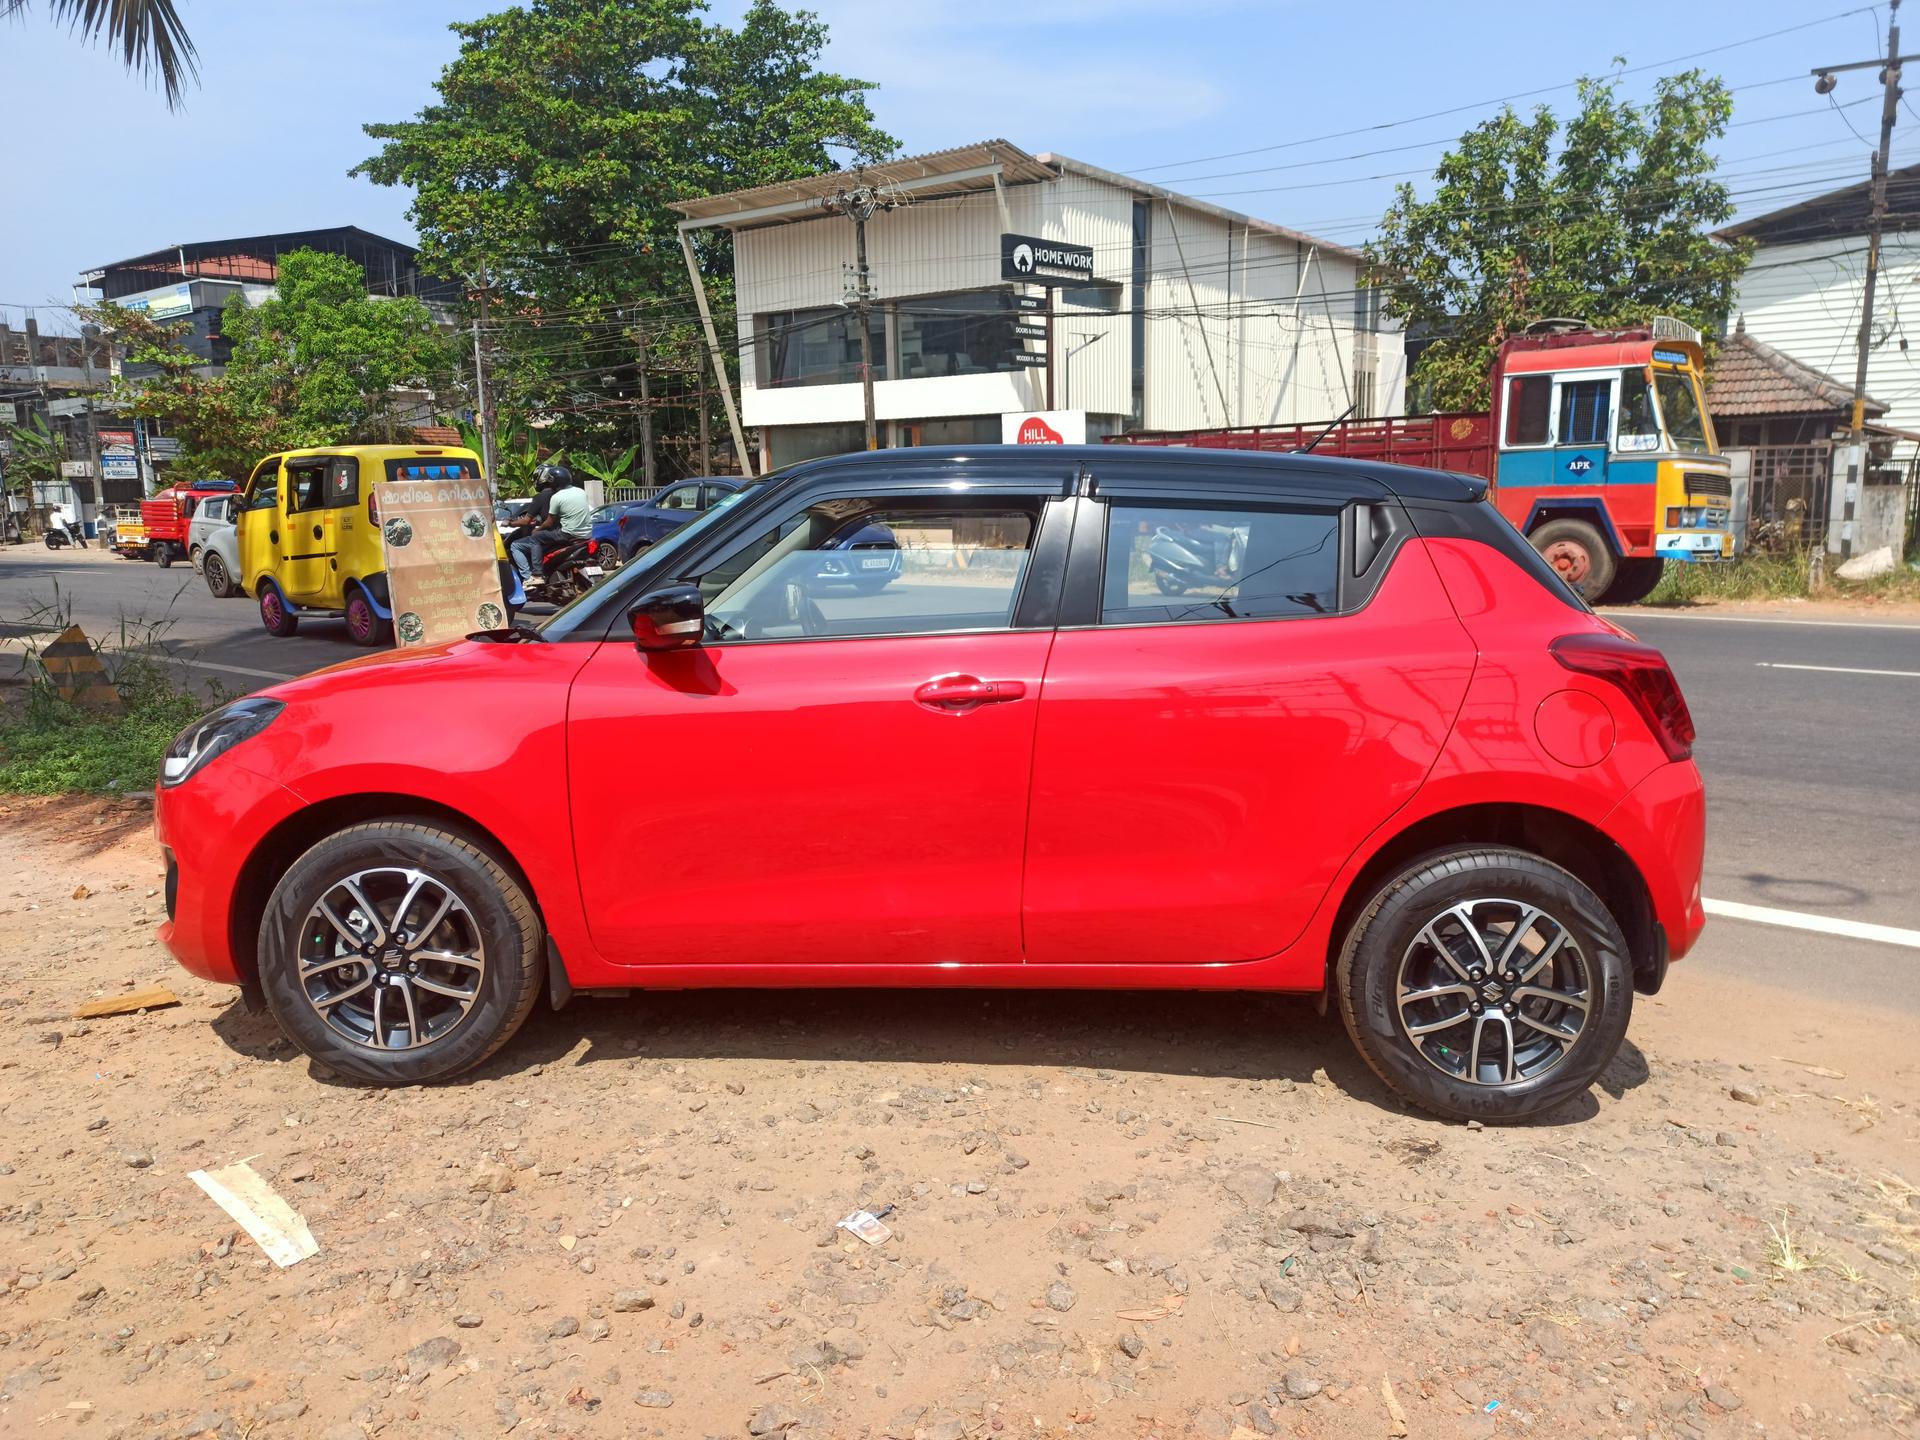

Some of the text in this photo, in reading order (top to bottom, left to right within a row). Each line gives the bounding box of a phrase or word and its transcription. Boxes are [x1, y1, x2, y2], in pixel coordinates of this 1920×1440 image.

[1034, 247, 1093, 269] HOMEWORK
[1024, 427, 1047, 441] HILL
[1569, 461, 1591, 470] APK
